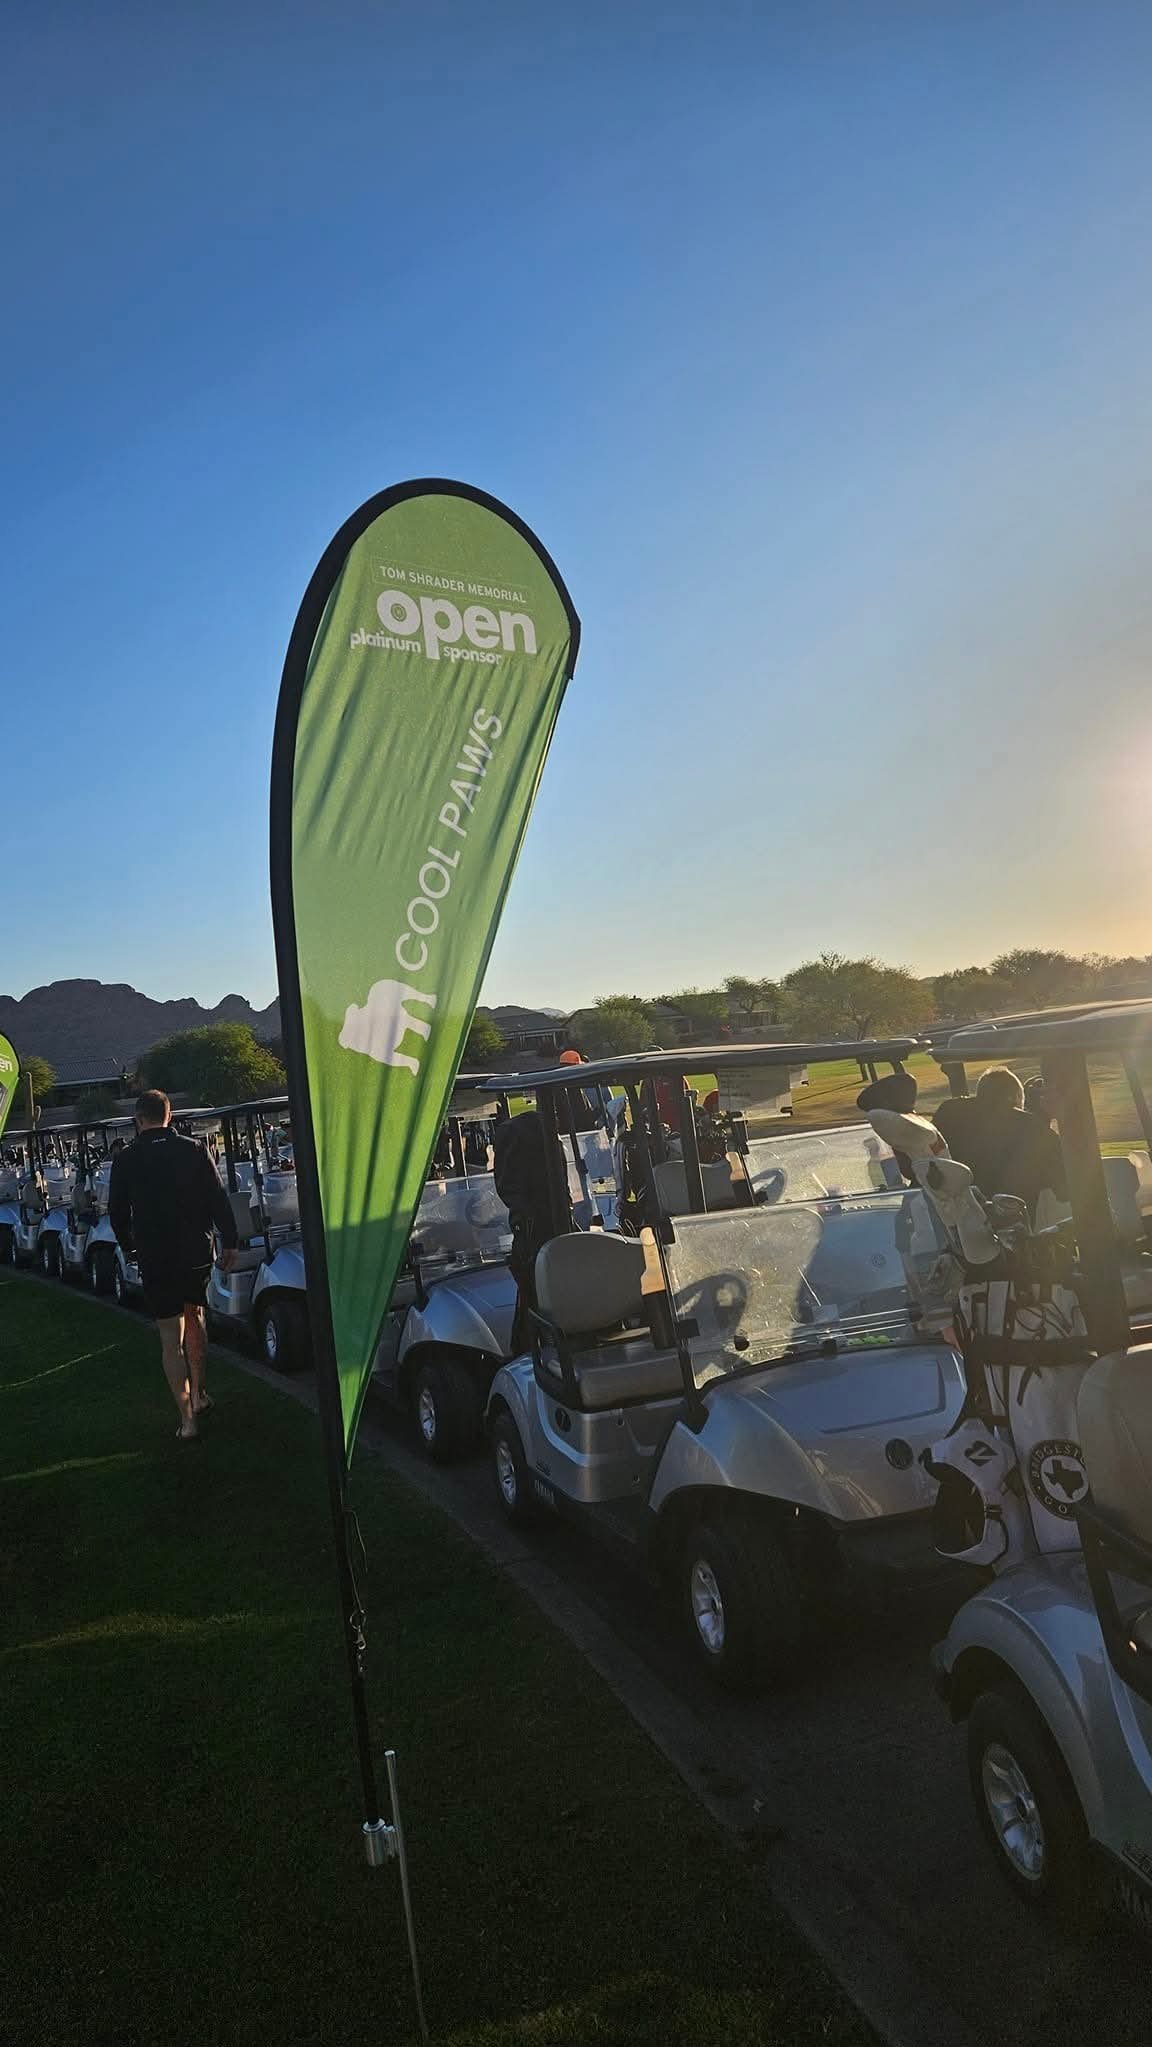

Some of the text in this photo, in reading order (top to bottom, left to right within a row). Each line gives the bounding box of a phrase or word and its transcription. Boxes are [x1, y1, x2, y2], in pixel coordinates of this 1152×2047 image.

[379, 565, 527, 603] TOM SHRADER MEMORIAL
[350, 628, 502, 664] platinum sponsor
[376, 589, 537, 660] open
[395, 708, 502, 971] COOL PAWS
